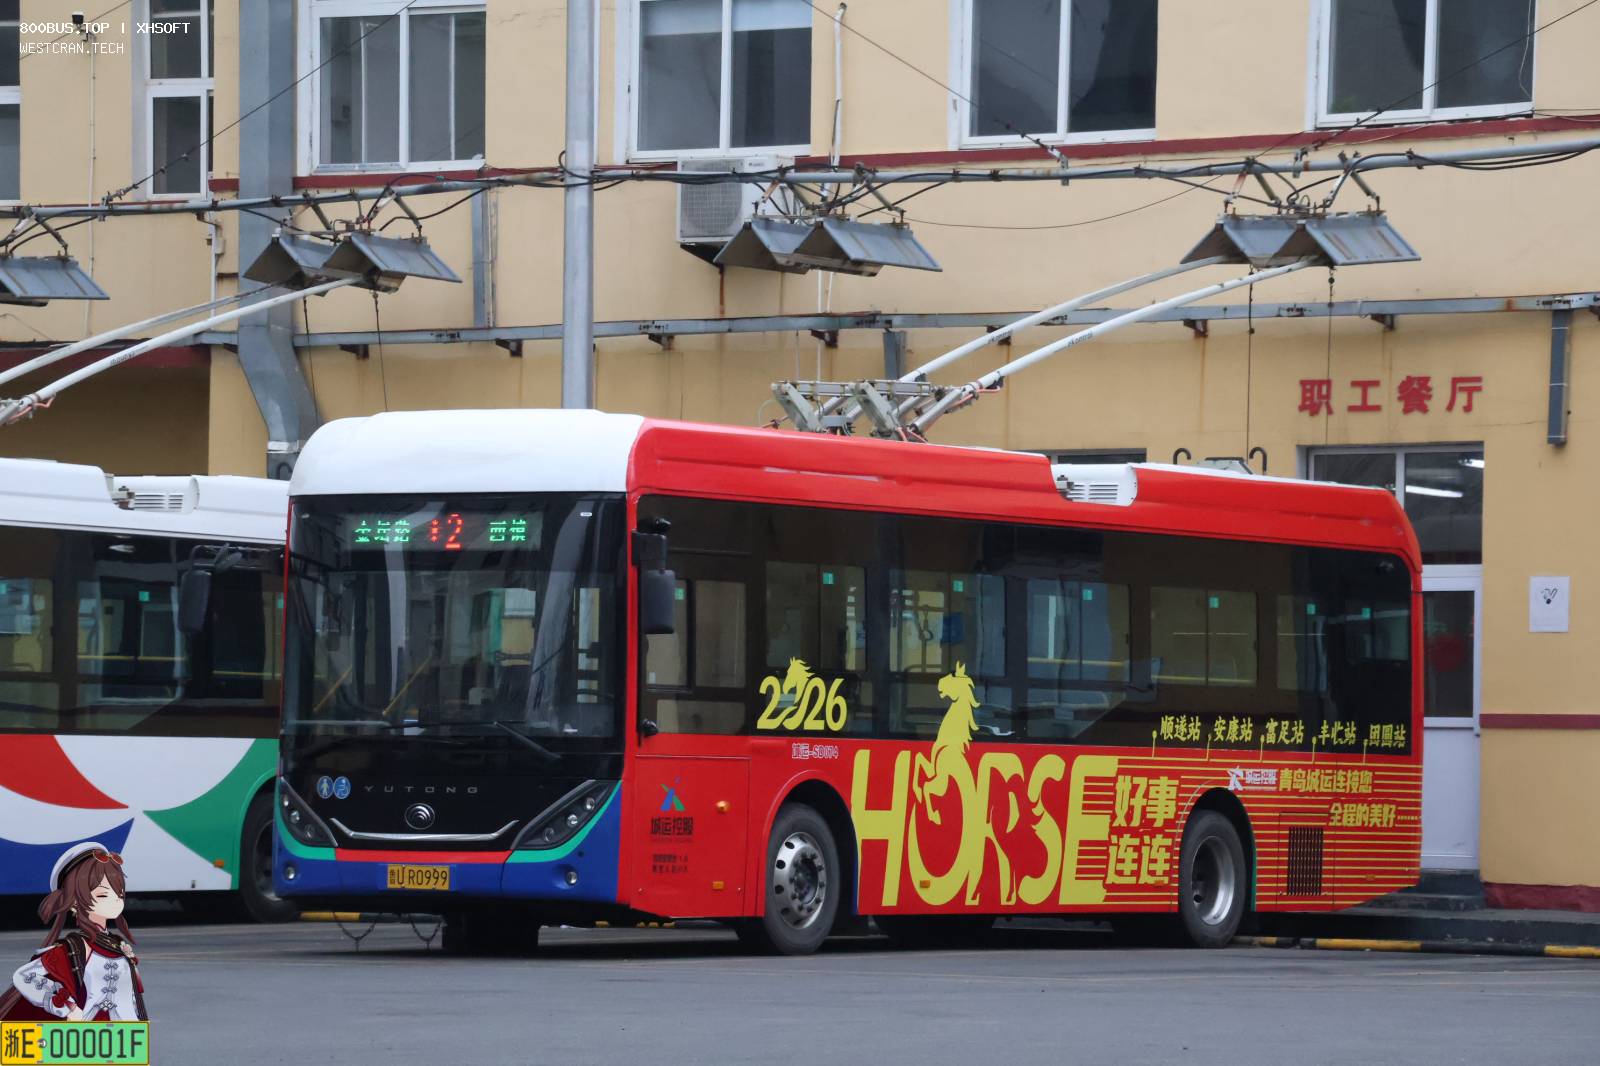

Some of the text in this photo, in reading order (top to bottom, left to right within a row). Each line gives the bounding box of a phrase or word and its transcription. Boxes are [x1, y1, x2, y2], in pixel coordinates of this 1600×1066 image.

[1298, 375, 1483, 417] 职工餐厅
[430, 513, 464, 550] 12
[1160, 714, 1201, 741] 顺遂站
[1213, 715, 1253, 743] 安康站
[1265, 717, 1304, 745] 富足站
[364, 784, 479, 795] YUTONG
[1279, 767, 1374, 794] 青岛城运连接您
[1111, 775, 1180, 828] 好事
[650, 816, 694, 836] 城运控股
[850, 748, 1119, 908] HORSE
[1105, 834, 1174, 886] 连连
